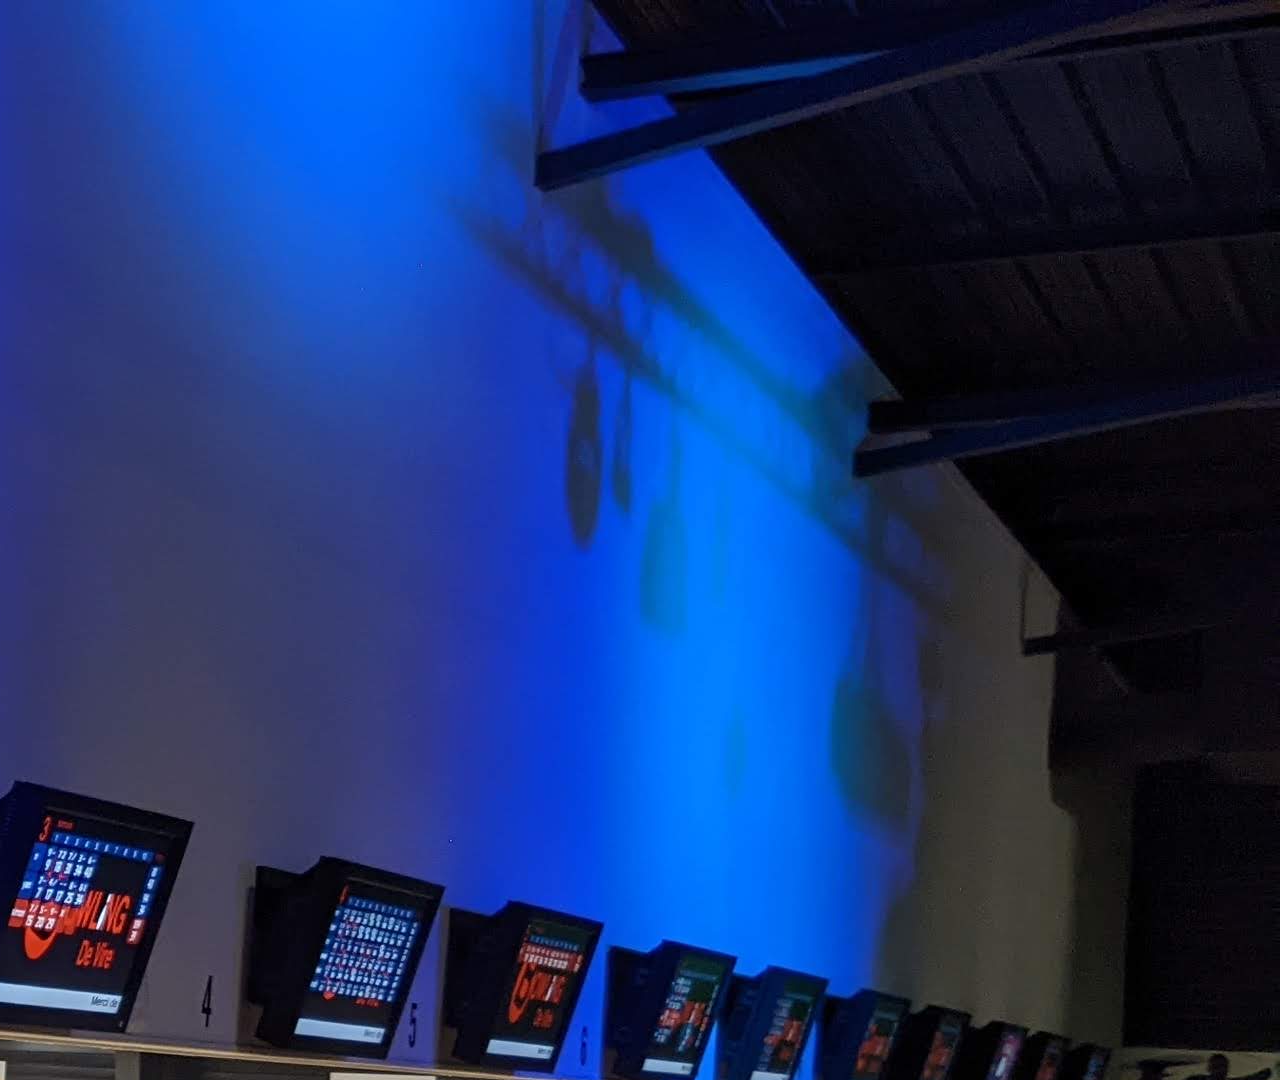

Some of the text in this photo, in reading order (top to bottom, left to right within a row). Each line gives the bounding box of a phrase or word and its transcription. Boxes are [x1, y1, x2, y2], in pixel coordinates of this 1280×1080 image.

[39, 815, 52, 841] 3
[64, 892, 75, 904] 25
[76, 940, 116, 970] De Vire
[202, 975, 212, 1027] 4
[409, 1003, 418, 1048] 5
